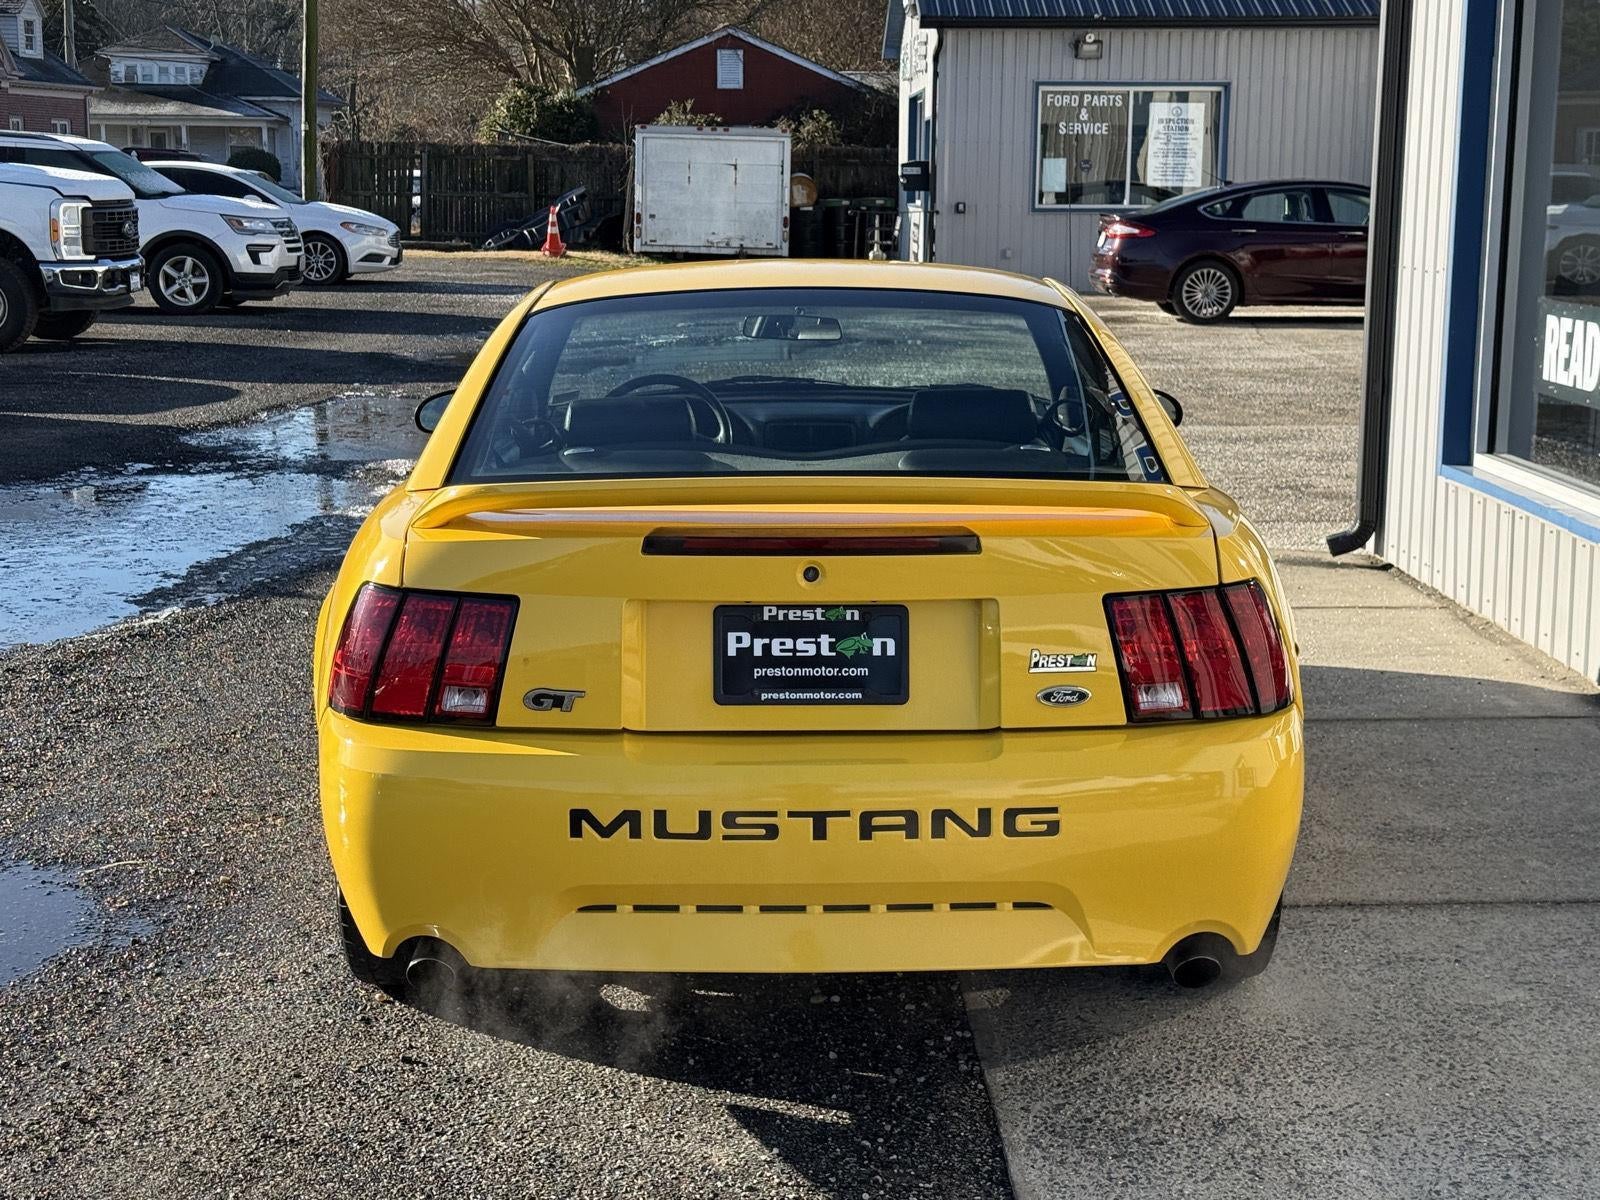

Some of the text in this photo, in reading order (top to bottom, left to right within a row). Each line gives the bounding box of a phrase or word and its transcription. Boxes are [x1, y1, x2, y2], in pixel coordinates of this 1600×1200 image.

[1046, 93, 1123, 107] FORD PARTS
[1079, 107, 1089, 121] &
[1058, 121, 1109, 135] SERVICE
[763, 605, 860, 621] Prestn
[727, 631, 896, 658] Prestn
[754, 666, 869, 679] prestonmotor.com
[523, 687, 586, 712] GT
[761, 690, 863, 701] prestonmotor.com
[1050, 689, 1079, 703] Ford
[568, 806, 1060, 841] MUSTANG
